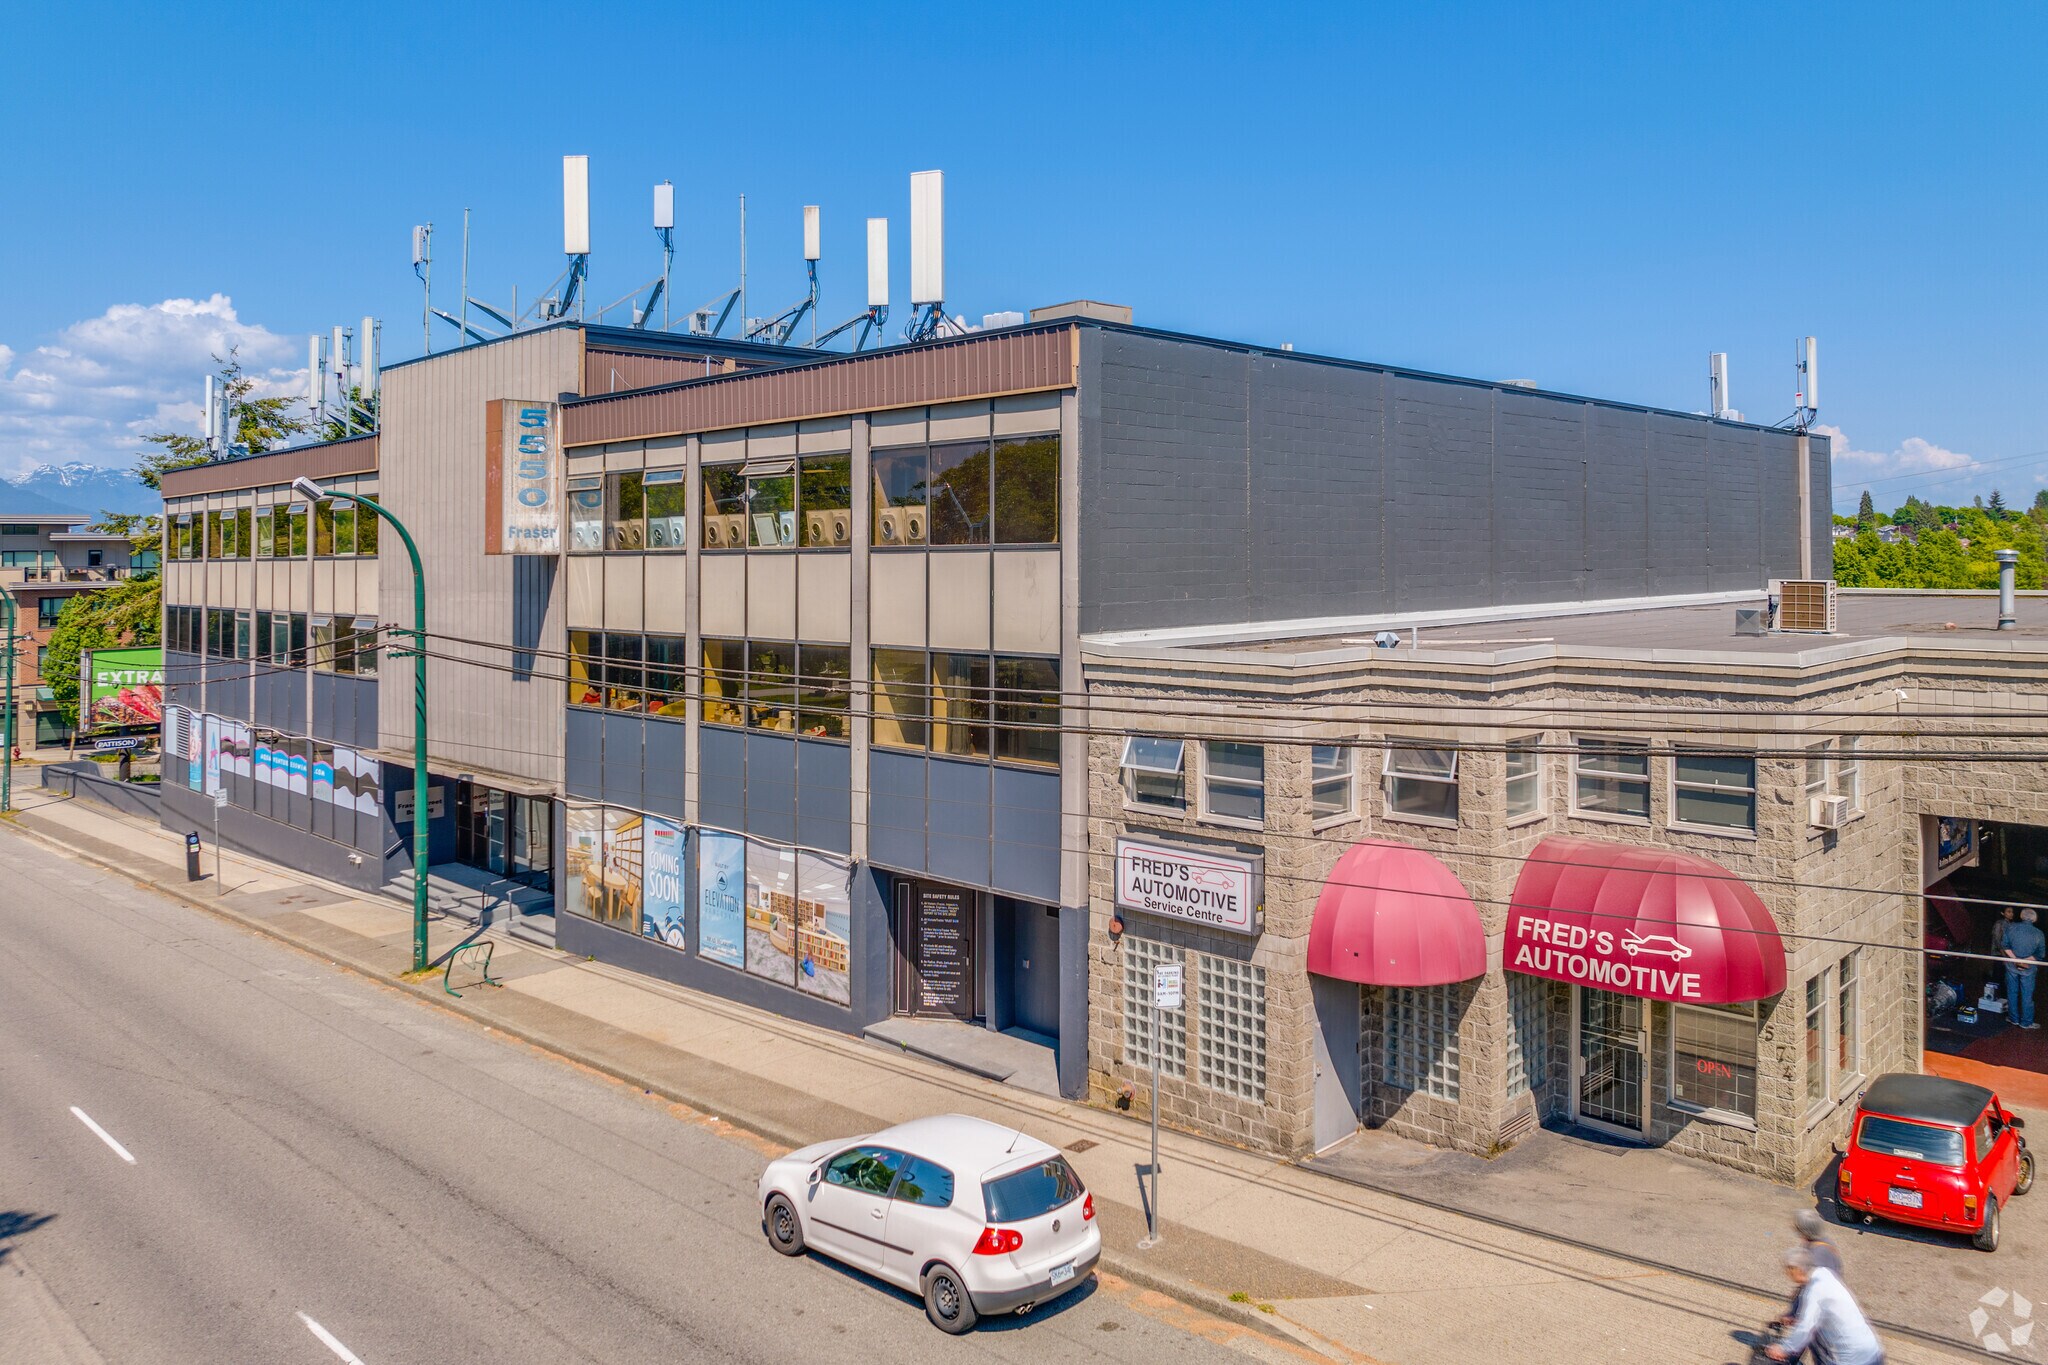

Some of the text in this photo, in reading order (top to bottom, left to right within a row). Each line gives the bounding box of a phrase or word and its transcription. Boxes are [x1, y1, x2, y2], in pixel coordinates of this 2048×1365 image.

[518, 408, 549, 508] 5550
[508, 526, 557, 539] Fraser
[97, 670, 163, 688] EXTRA
[98, 738, 134, 748] PATTISON
[649, 850, 679, 876] COMING
[1132, 855, 1190, 881] FRED'S
[649, 871, 679, 904] SOON
[1132, 876, 1237, 912] AUTOMOTIVE
[705, 888, 741, 914] ELEVATION
[1144, 896, 1223, 923] Service Centre
[1516, 916, 1615, 956] FRED'S
[1514, 944, 1702, 998] AUTOMOTIVE
[1697, 1059, 1732, 1079] OPEN
